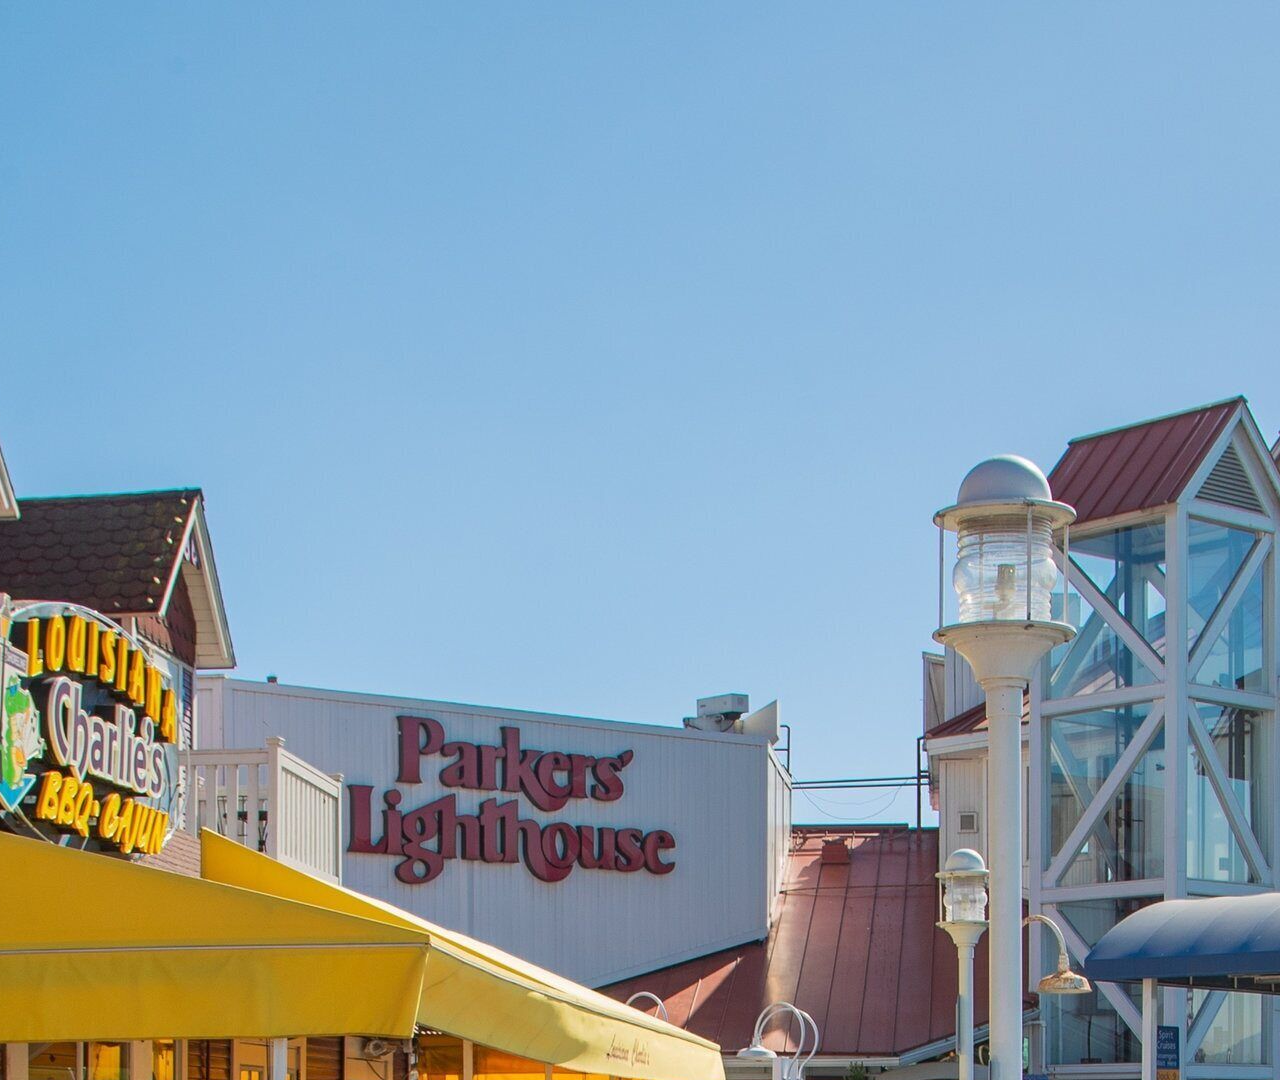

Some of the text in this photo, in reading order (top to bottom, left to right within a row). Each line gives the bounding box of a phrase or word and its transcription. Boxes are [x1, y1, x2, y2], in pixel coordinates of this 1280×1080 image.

[27, 614, 176, 744] LOUISIANA
[46, 676, 165, 799] Charlie's
[396, 715, 634, 812] Parkers'
[347, 784, 676, 884] Lighthouse
